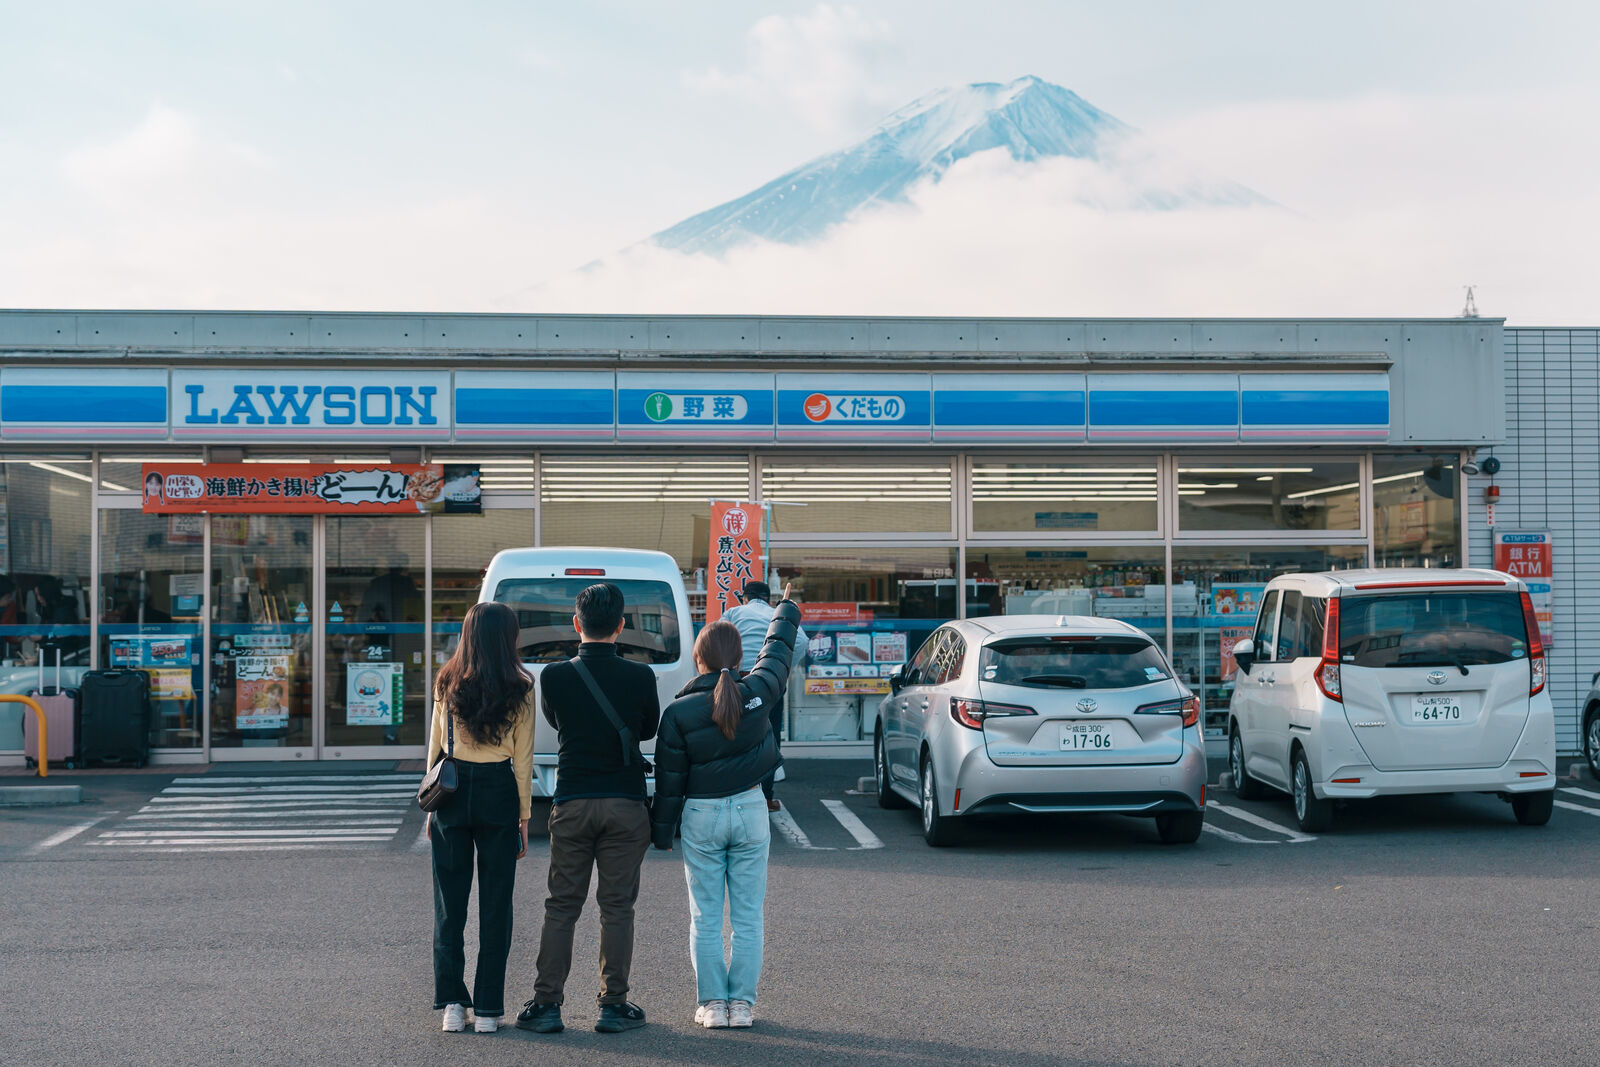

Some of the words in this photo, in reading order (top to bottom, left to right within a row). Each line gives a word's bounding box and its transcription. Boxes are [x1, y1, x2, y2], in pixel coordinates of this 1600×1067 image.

[185, 384, 437, 425] LAWSON
[683, 396, 735, 418] 野菜
[835, 398, 899, 418] くだもの
[206, 476, 324, 497] 海鮮かき揚げ
[1509, 547, 1540, 560] 銀行
[1507, 561, 1542, 575] ATM
[367, 646, 383, 656] 24
[1437, 697, 1451, 705] 500
[1423, 705, 1460, 720] 64-70
[1072, 725, 1087, 733] 成田
[1088, 725, 1102, 733] 300
[1073, 733, 1111, 748] 17-06
